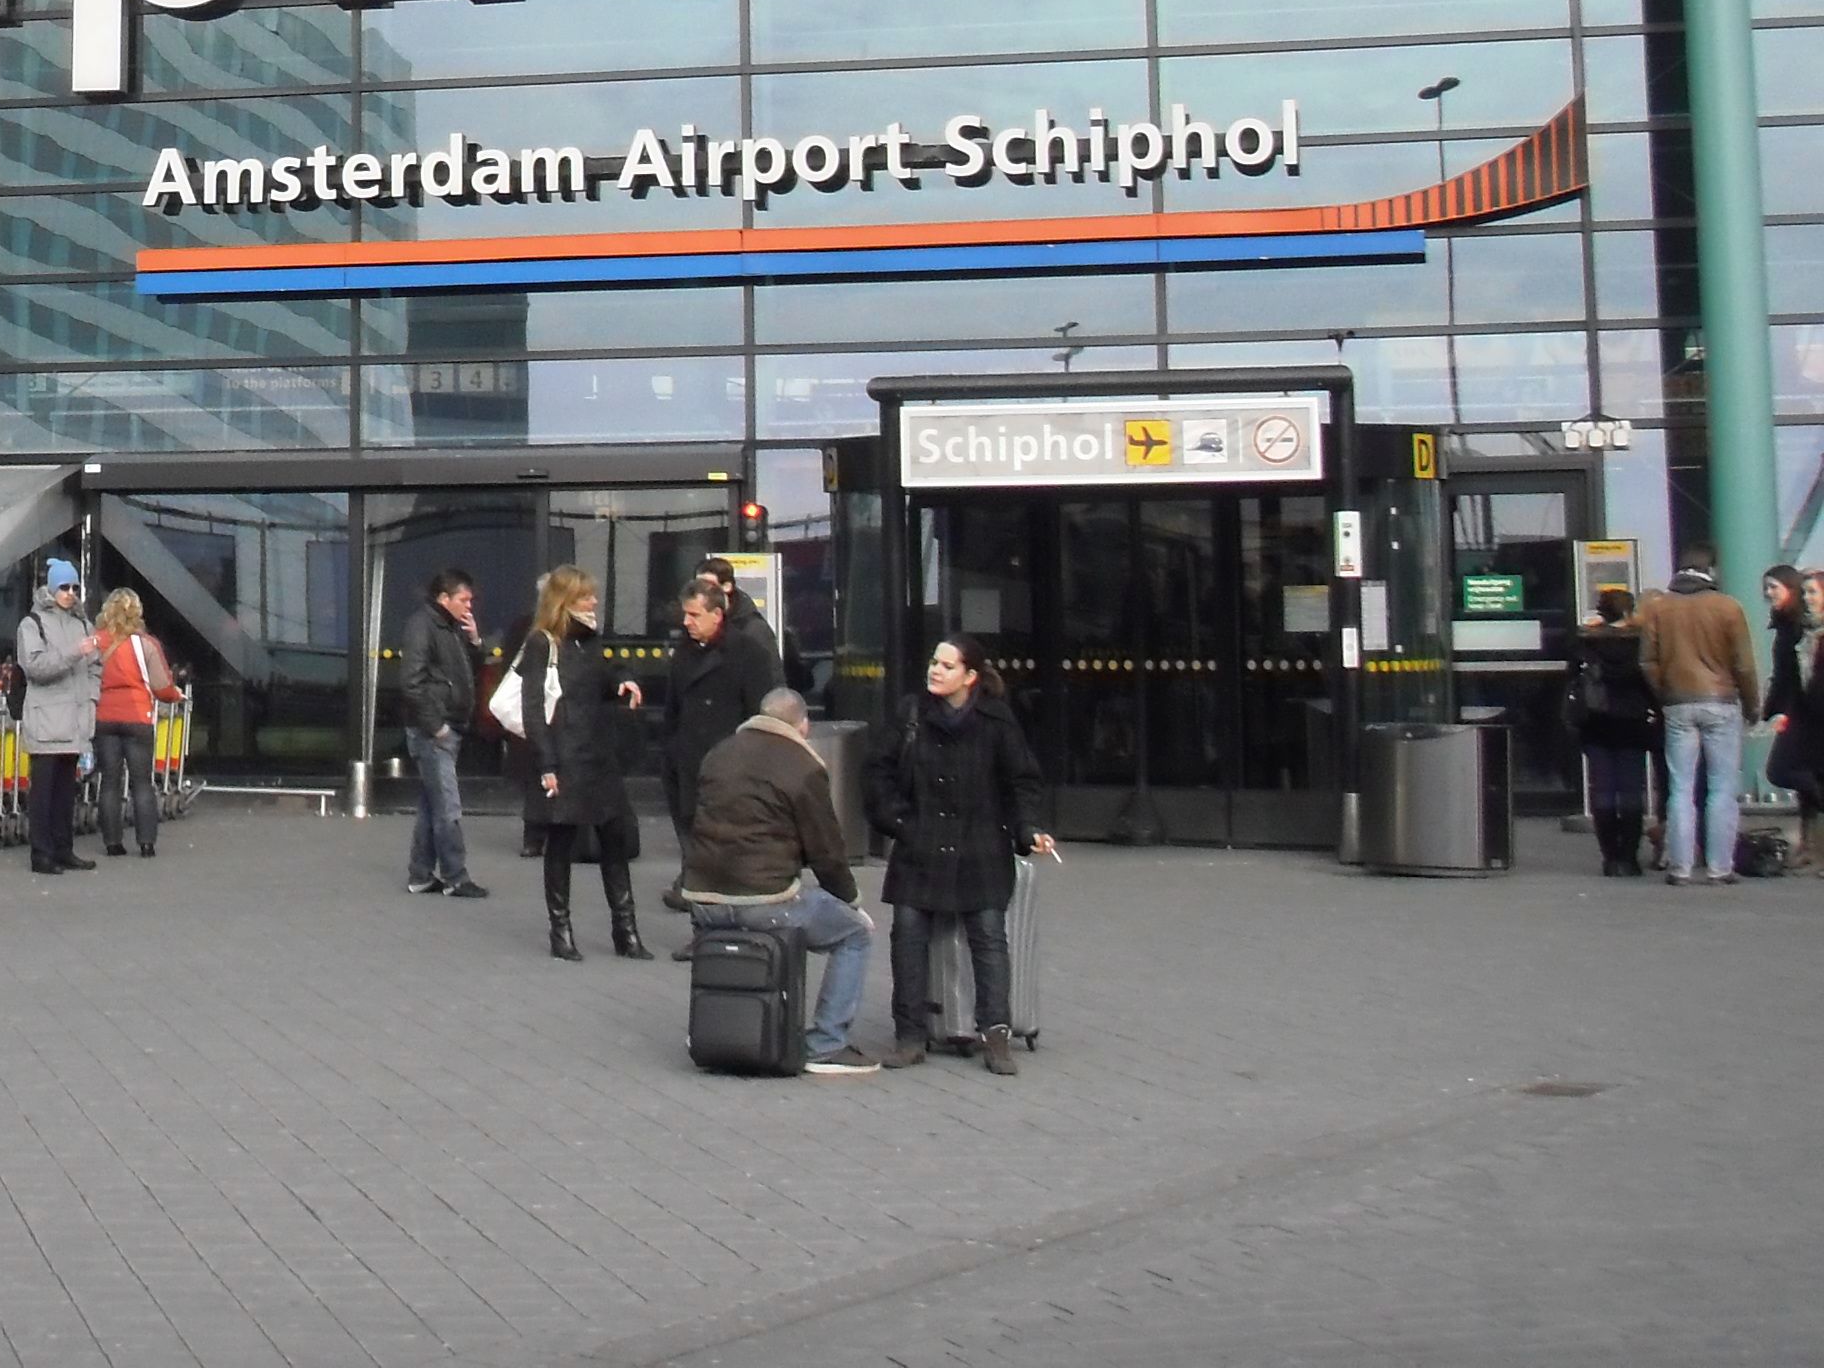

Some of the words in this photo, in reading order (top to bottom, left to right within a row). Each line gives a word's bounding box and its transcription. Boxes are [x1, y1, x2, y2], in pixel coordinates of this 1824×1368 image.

[142, 133, 585, 207] Amsterdam
[617, 122, 912, 201] Airport
[944, 99, 1299, 188] Schiphol
[242, 377, 267, 390] the
[430, 370, 442, 390] 3
[470, 370, 483, 390] 4
[917, 422, 1114, 472] Schiphol
[1417, 438, 1431, 472] D
